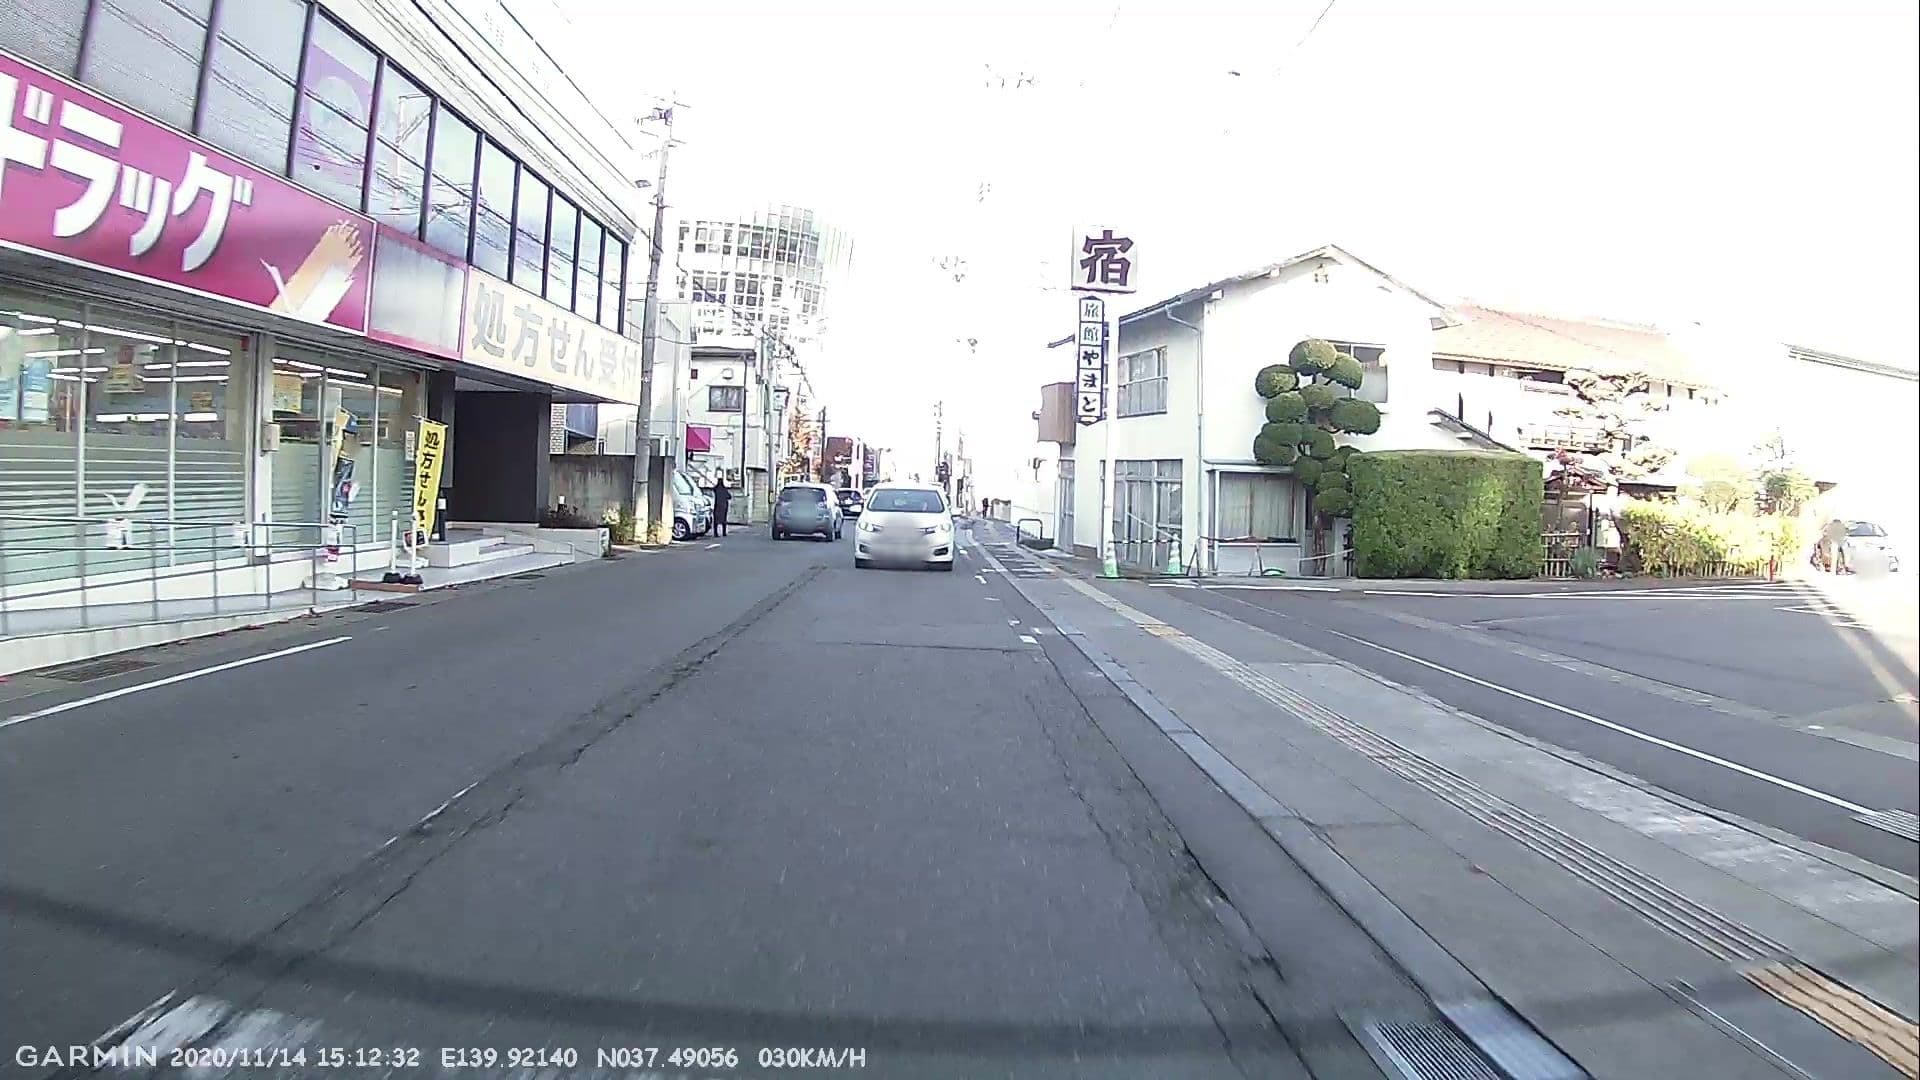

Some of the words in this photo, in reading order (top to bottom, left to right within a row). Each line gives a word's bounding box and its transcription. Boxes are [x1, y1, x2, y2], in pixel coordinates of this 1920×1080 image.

[0, 71, 253, 272] ドラッグ
[1080, 230, 1134, 286] 宿
[1082, 302, 1100, 413] 旅館やまと
